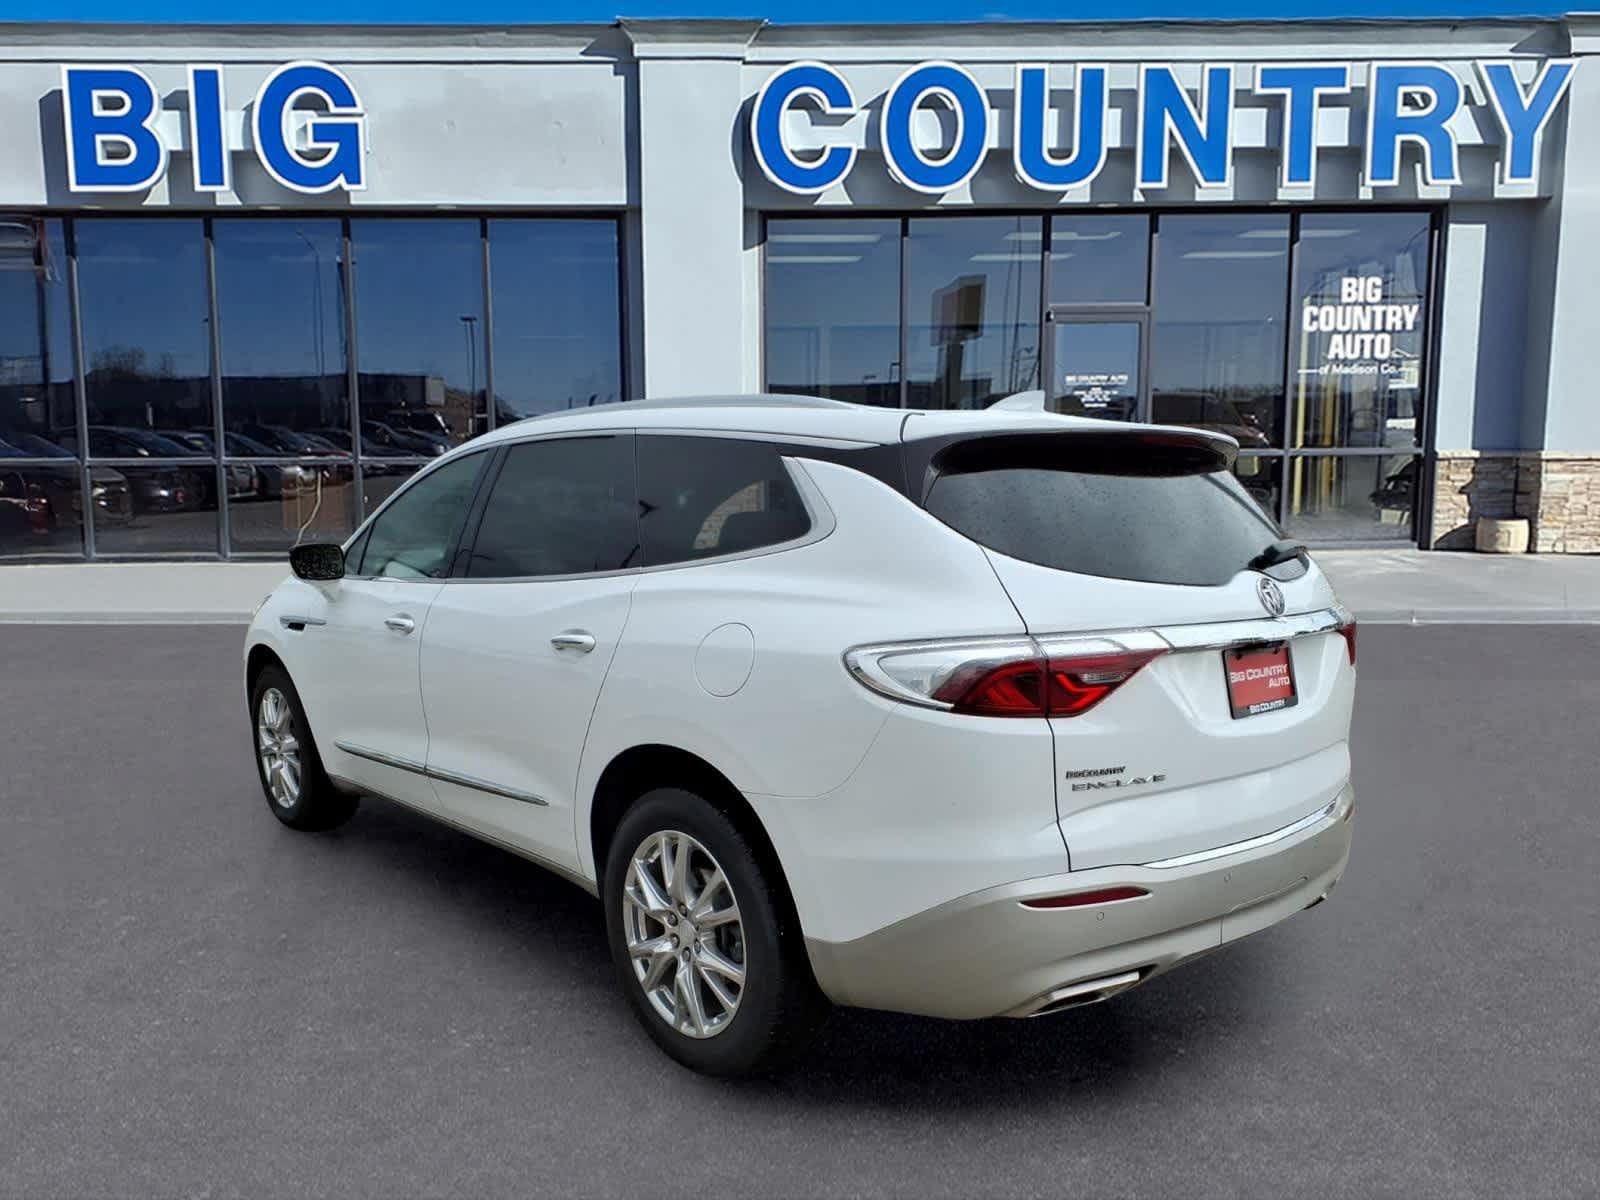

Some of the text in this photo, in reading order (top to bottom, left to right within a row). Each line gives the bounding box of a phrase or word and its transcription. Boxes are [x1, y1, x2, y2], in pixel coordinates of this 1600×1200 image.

[60, 58, 1574, 196] BIG COUNTRY
[1341, 276, 1382, 303] BIG
[1302, 304, 1420, 332] COUNTRY
[1327, 333, 1391, 360] AUTO
[1230, 664, 1288, 683] BIG COUNTRY
[1268, 676, 1290, 688] AUTO
